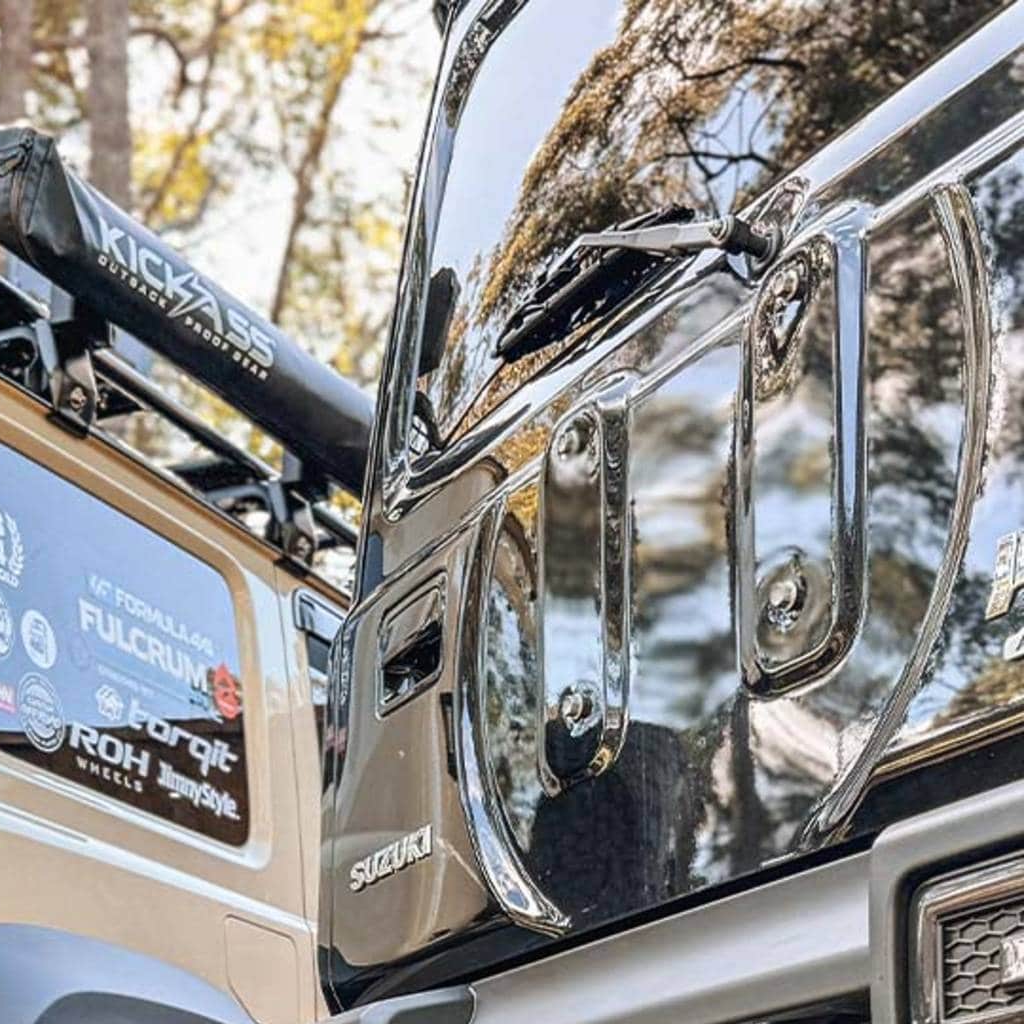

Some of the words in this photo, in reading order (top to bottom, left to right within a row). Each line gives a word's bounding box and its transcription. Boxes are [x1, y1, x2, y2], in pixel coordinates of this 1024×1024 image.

[97, 254, 168, 311] OUTBACK
[184, 315, 228, 353] PROOF
[232, 350, 270, 381] GEAR
[78, 598, 208, 693] FULCRUM
[69, 721, 151, 777] ROH
[76, 755, 143, 792] WHEELS
[128, 699, 239, 777] torqit
[349, 824, 433, 892] SUZUKI
